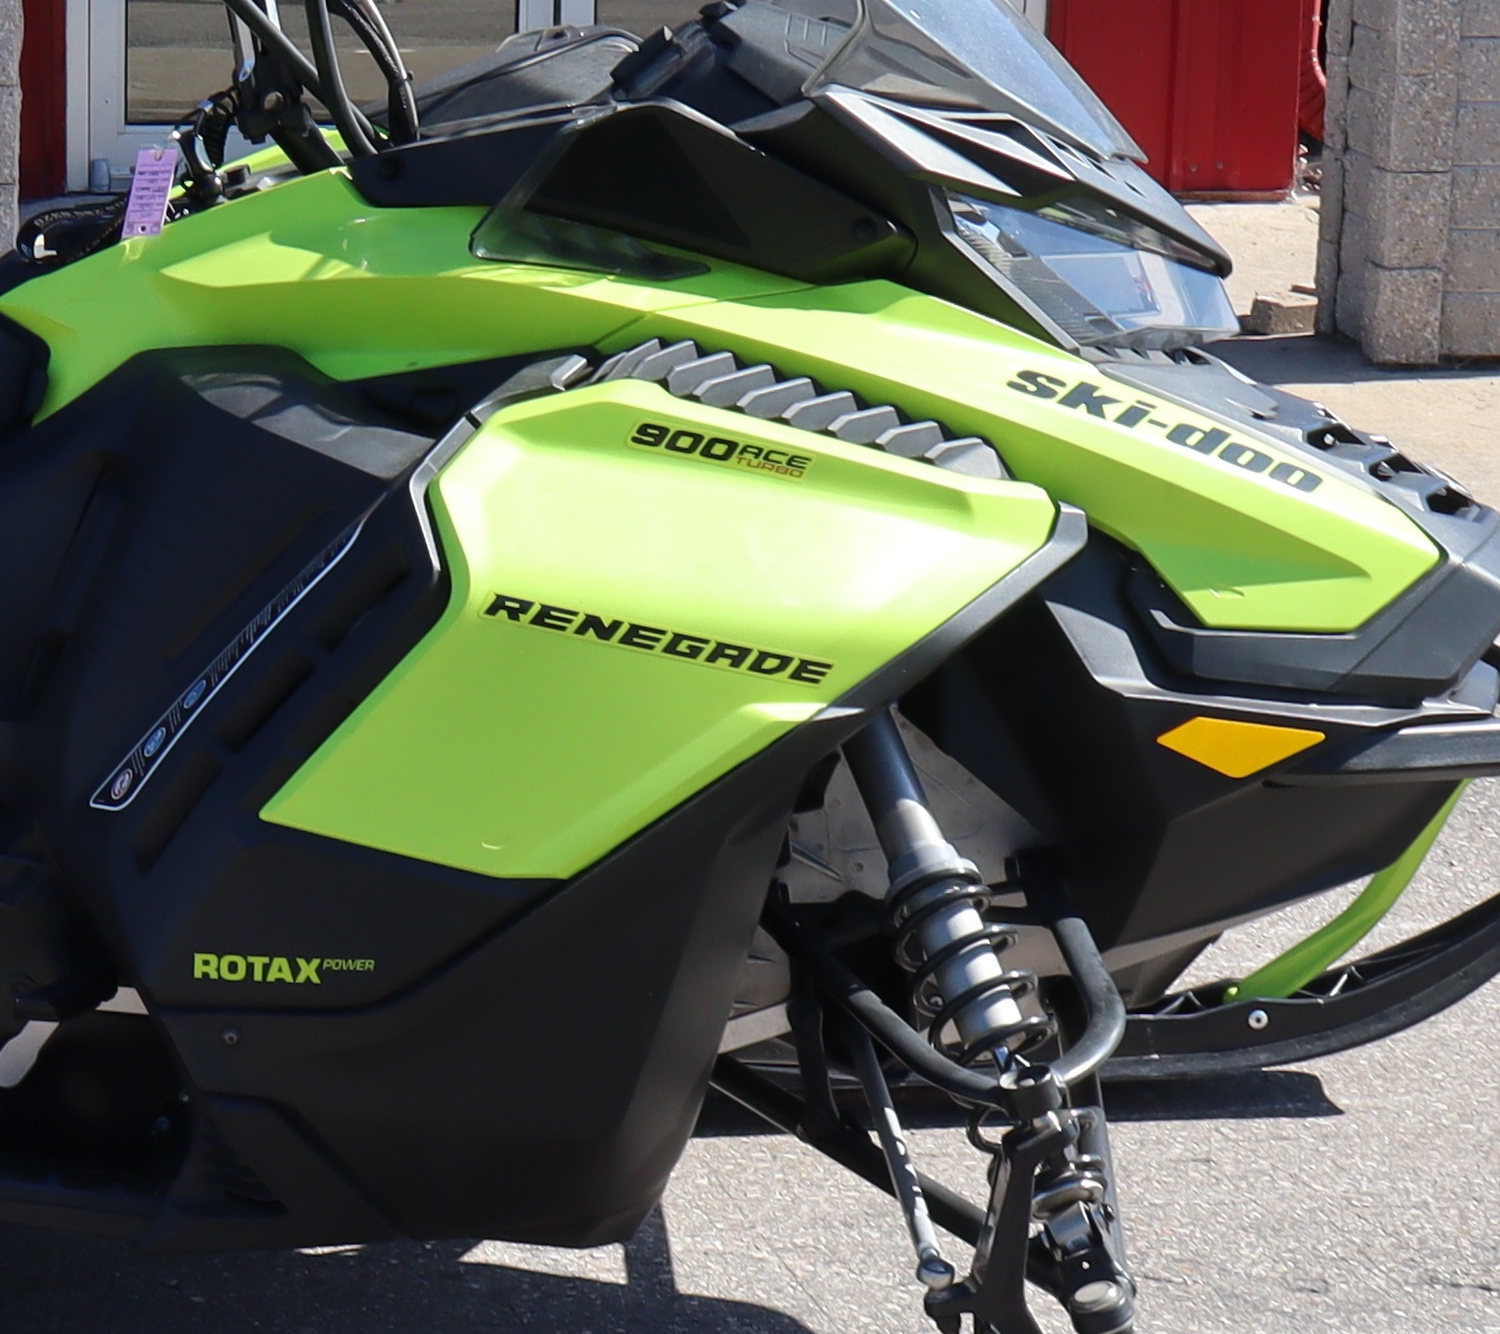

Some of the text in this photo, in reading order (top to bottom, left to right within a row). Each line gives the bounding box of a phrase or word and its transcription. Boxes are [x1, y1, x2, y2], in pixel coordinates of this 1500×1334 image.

[631, 423, 812, 470] 900 ACE
[735, 456, 805, 479] TURBO
[483, 593, 835, 685] RENEGADE
[193, 953, 375, 984] ROTAX POWER
